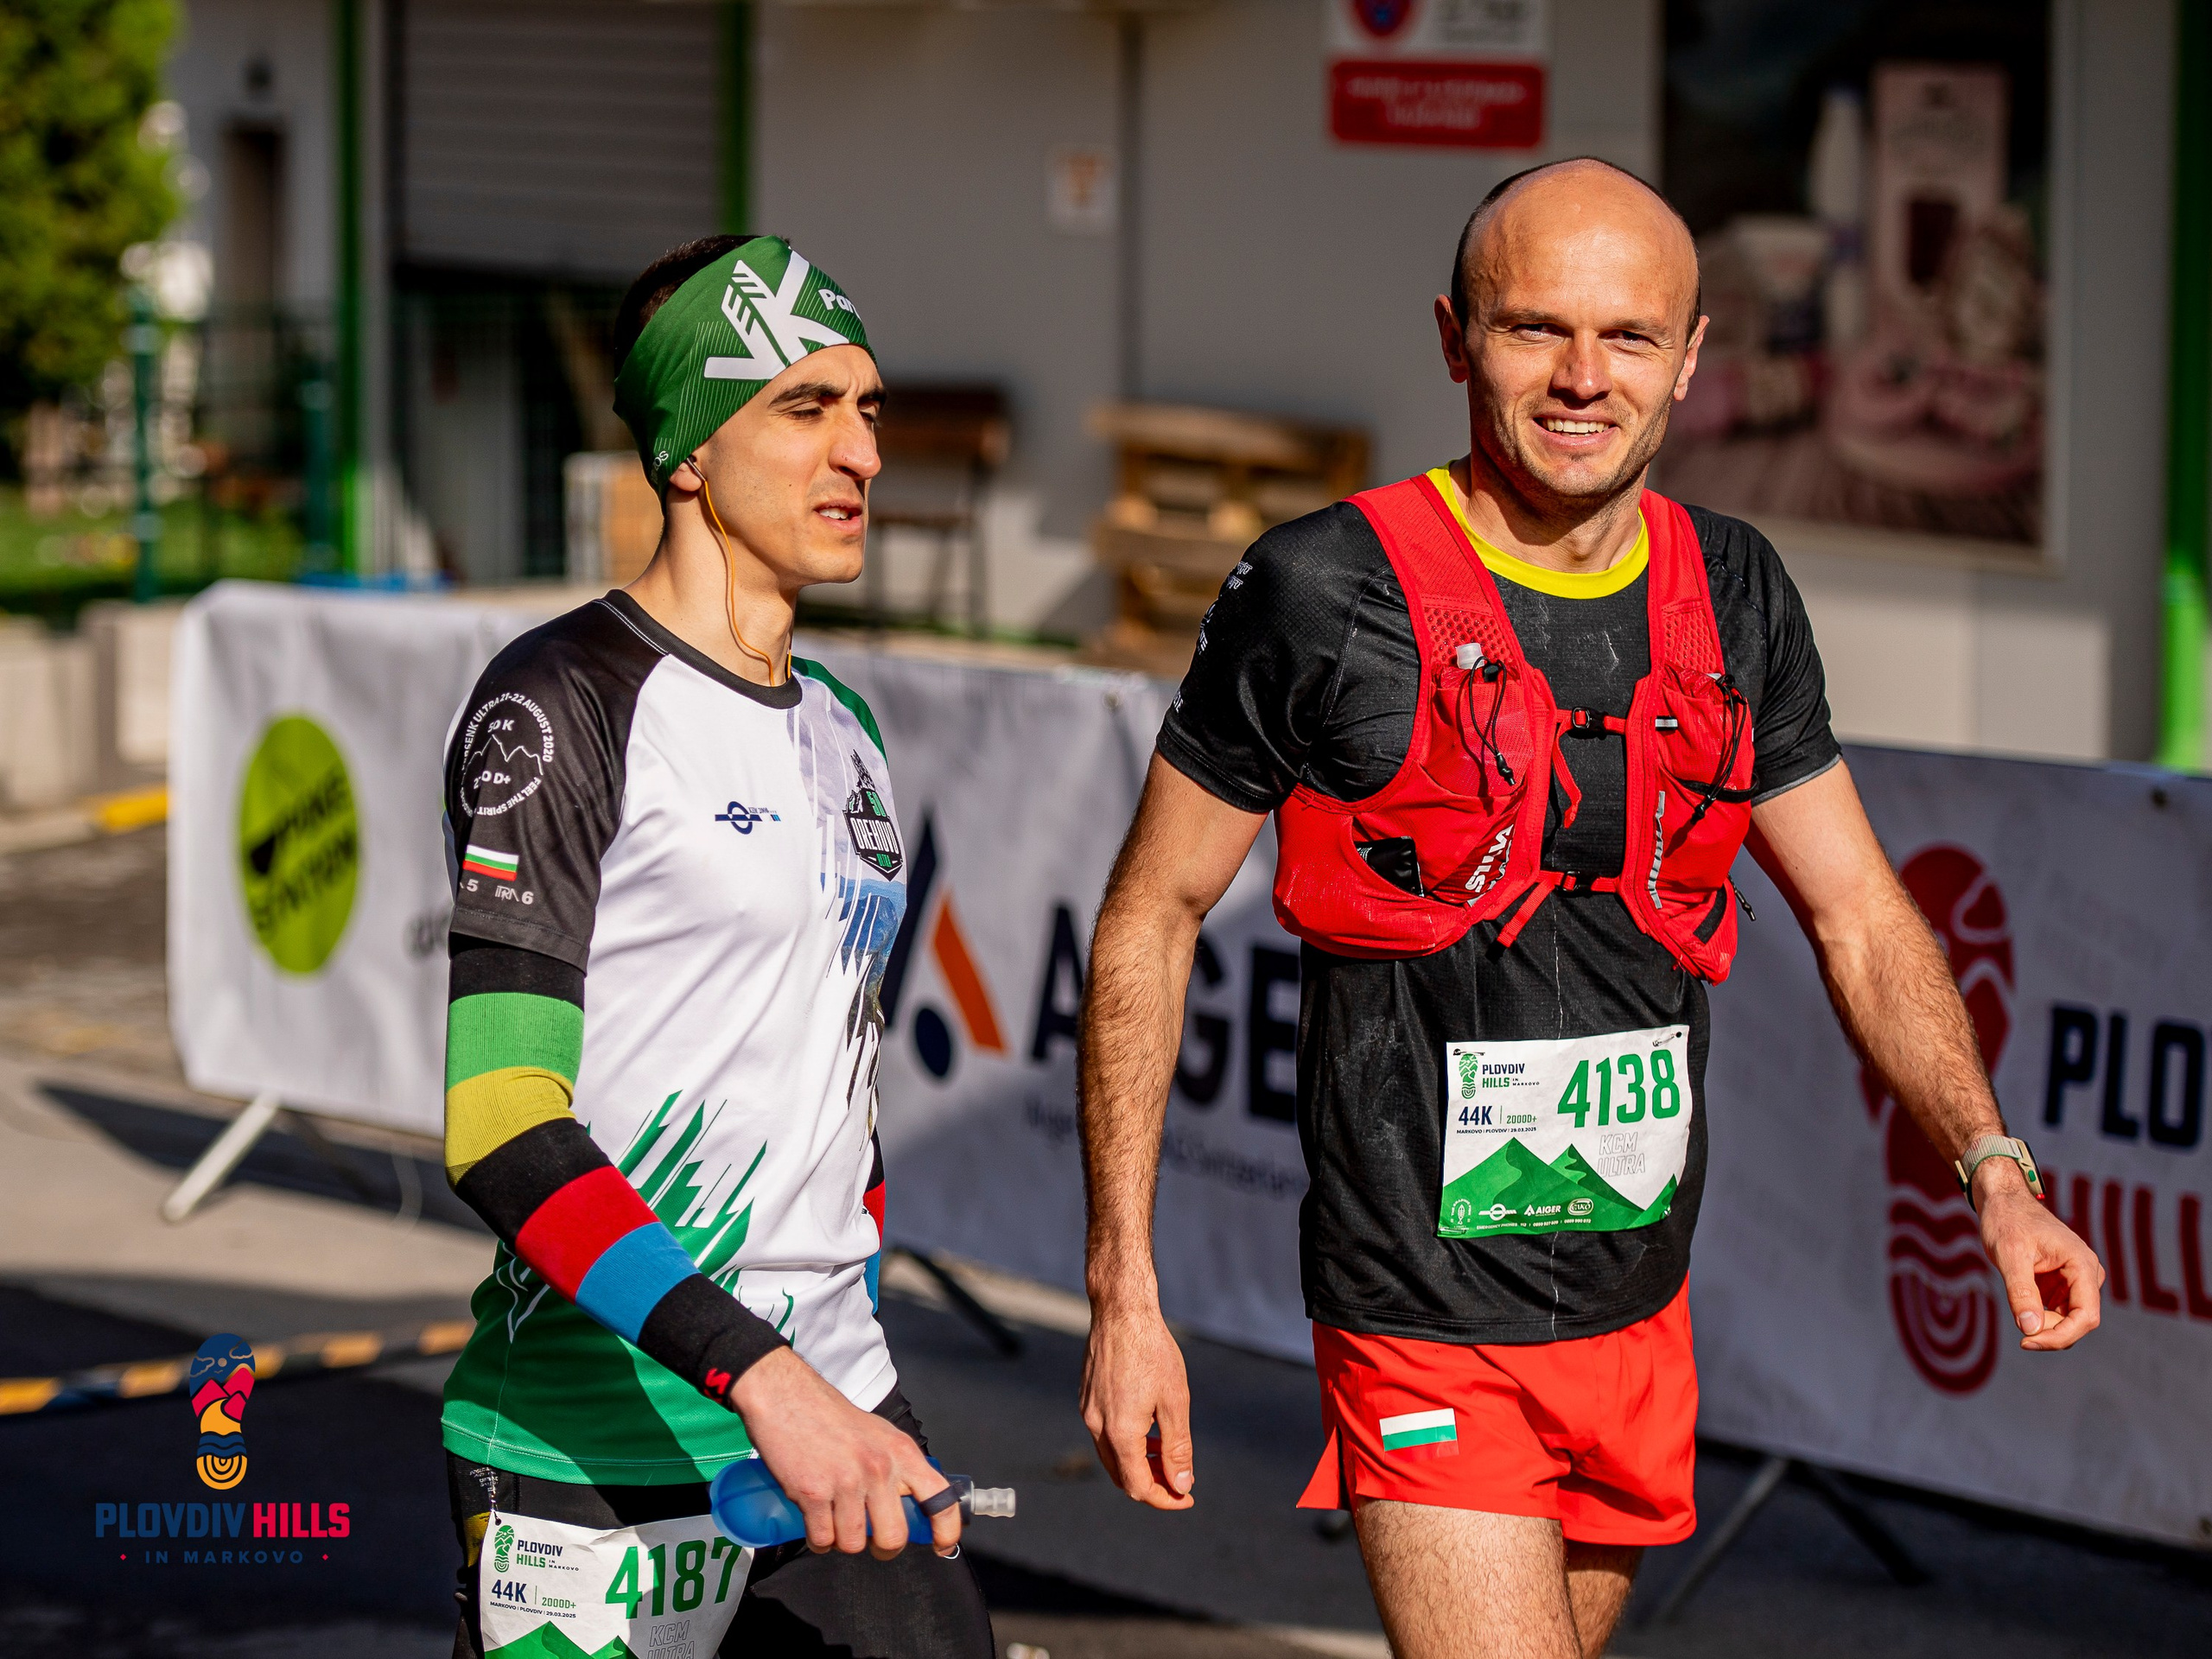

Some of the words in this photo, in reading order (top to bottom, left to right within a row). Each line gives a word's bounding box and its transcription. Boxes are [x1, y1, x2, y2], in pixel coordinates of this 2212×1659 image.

[473, 696, 499, 724] ULTRA
[522, 699, 553, 734] AUGUST
[543, 734, 554, 762] 2020
[501, 719, 515, 732] K
[493, 772, 512, 785] D+
[520, 777, 542, 797] FEEL
[477, 803, 508, 817] SPIRIT
[505, 792, 525, 809] THE
[849, 817, 900, 855] OREHOVO
[467, 878, 480, 893] 5
[521, 891, 535, 905] 6
[1031, 899, 1298, 1125] AGE
[1482, 1063, 1525, 1075] PLOVDIV
[2043, 1001, 2207, 1151] PLO
[1482, 1077, 1510, 1088] HILLS
[1557, 1049, 1681, 1128] 4138
[1458, 1105, 1492, 1126] 44K
[1599, 1131, 1639, 1156] KCM
[1597, 1152, 1646, 1178] ULTRA
[1535, 1205, 1561, 1215] AIGER
[2040, 1166, 2212, 1324] HILL
[517, 1539, 563, 1557] PLOVDIV
[516, 1554, 546, 1568] HILLS
[606, 1535, 743, 1620] 4187
[491, 1579, 527, 1605] 44K
[541, 1597, 576, 1609] 2000D+
[490, 1601, 518, 1611] MARKOVO
[519, 1606, 543, 1615] PLOVDIV
[545, 1611, 577, 1619] 29.03.2025
[649, 1619, 690, 1648] KCM
